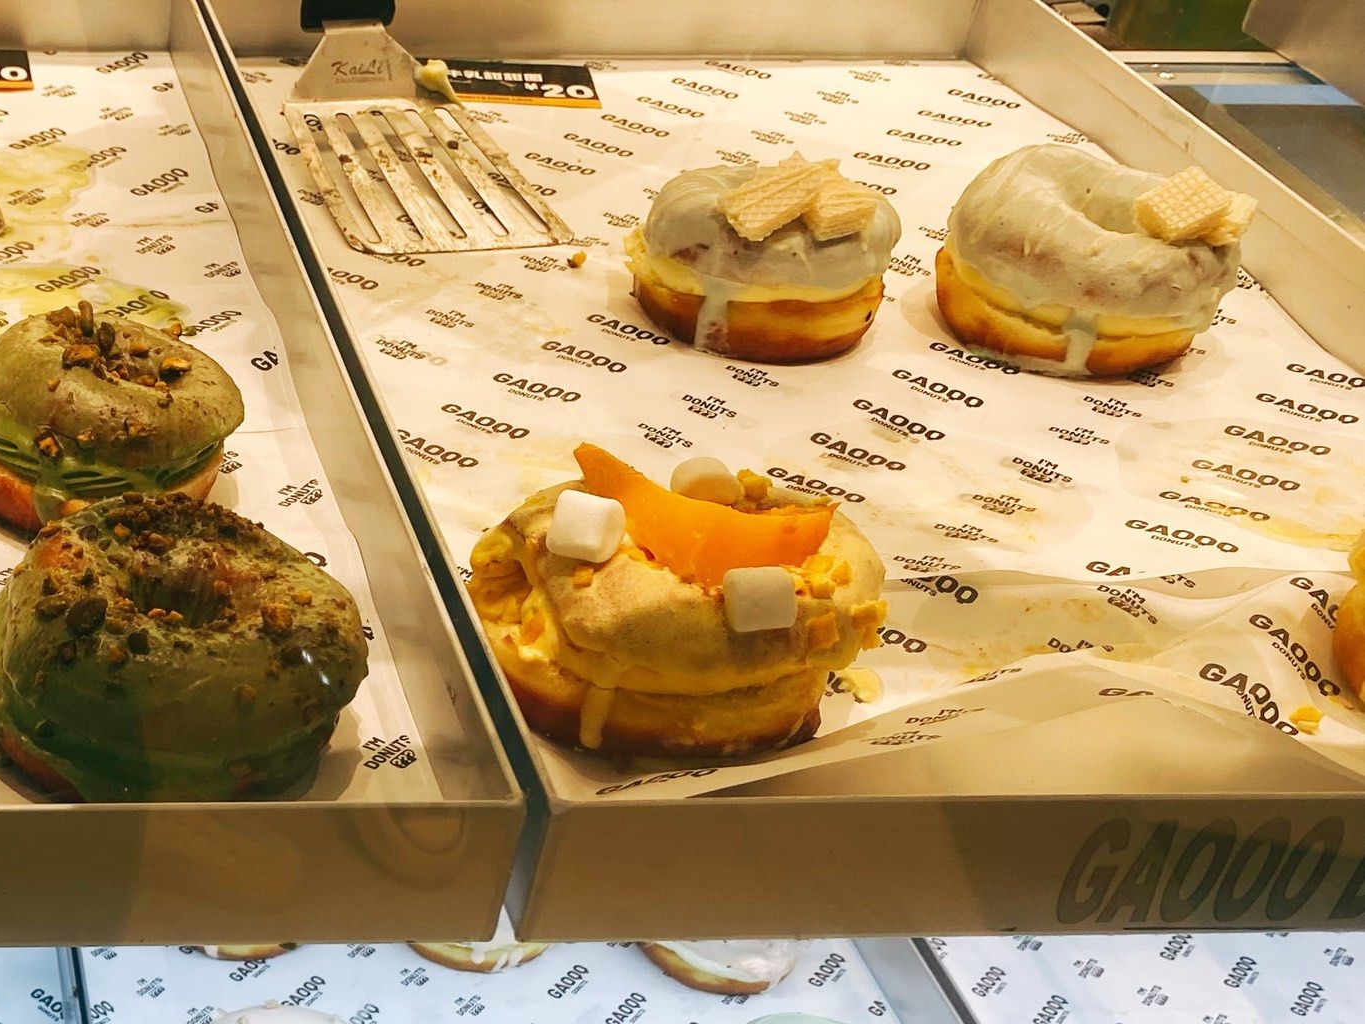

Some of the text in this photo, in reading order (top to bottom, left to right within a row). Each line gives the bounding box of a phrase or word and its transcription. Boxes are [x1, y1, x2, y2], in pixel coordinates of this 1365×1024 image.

[682, 395, 737, 417] DONUTS
[1083, 396, 1142, 417] DONUTS
[638, 423, 693, 447] DONUTS
[1012, 457, 1072, 483] DONUTS
